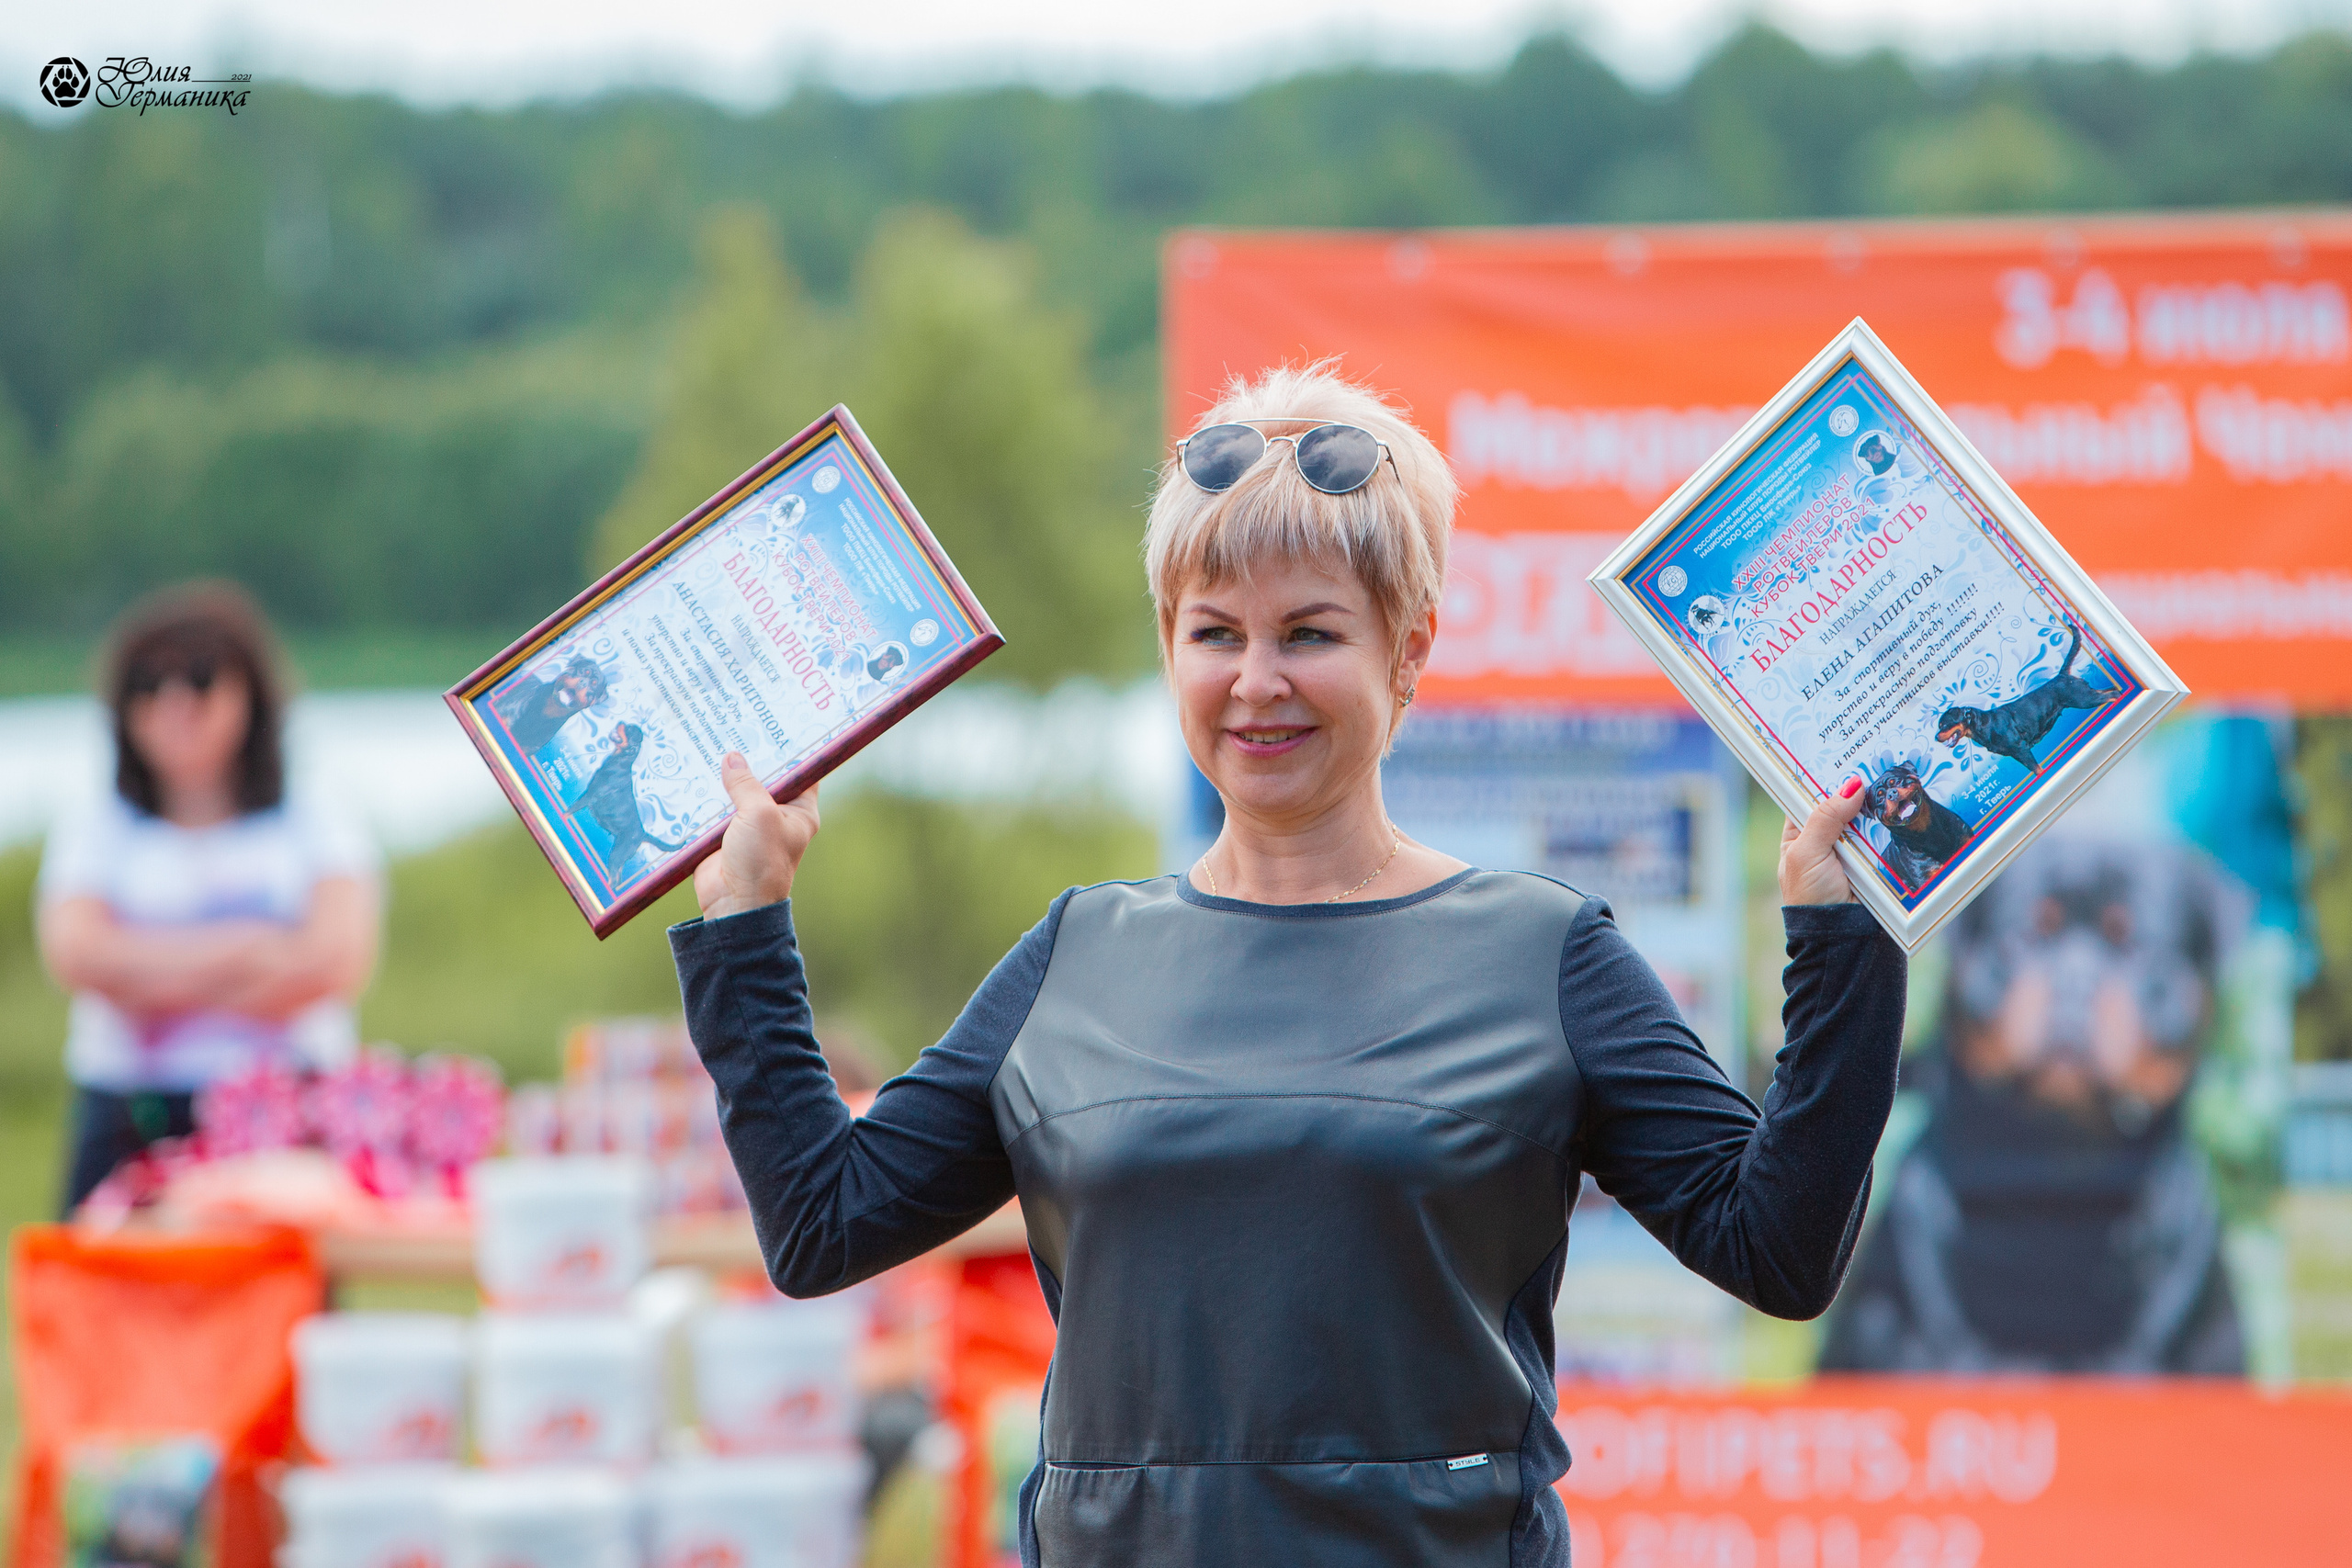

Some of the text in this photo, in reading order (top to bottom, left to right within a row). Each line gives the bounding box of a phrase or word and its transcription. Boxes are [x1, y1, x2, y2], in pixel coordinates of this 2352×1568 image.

[1693, 515, 1732, 554] РОССИЙСКАЯ
[1731, 465, 1783, 517] КИНОЛОГИЧЕСКАЯ
[1783, 433, 1819, 468] ФЕДЕРАЦИЯ
[1700, 509, 1750, 558] НАЦИОНАЛЬНЫЙ
[1746, 494, 1764, 513] КЛУБ
[1760, 469, 1791, 499] ПОРОДЫ
[1787, 439, 1821, 474] РОТВЕЙЛЕР
[1721, 460, 1812, 548] ТООО ПККЦ Биосфера-Союз
[1731, 556, 1767, 591] XXIII
[1764, 473, 1849, 556] ЧЕМПИОНАТ
[1742, 482, 1804, 540] ТООО ЛЖ «Тверь»
[1750, 498, 1852, 592] РОТВЕЙЛЕРОВ
[1666, 574, 1679, 587] FCI
[1748, 568, 1801, 617] КУБОК
[1794, 527, 1842, 575] ТВЕРИ
[1840, 494, 1877, 531] 2021
[1750, 503, 1927, 671] БЛАГОДАРНОСТЬ
[1819, 570, 1896, 645] НАГРАЖДАЕТСЯ
[1801, 565, 1943, 701] ЕЛЕНА АГАПИТОВА
[1819, 583, 1978, 743] упорство и веру в победу !!!!!!!
[1834, 602, 2004, 769] и показ участников выставки!!!!
[1835, 602, 1941, 702] За спортивный дух,
[1839, 608, 1976, 740] За прекрасную подготовку
[1962, 764, 1999, 799] 3-4 июля
[1974, 780, 2000, 803] 2021г.
[1984, 785, 2013, 810] Тверь
